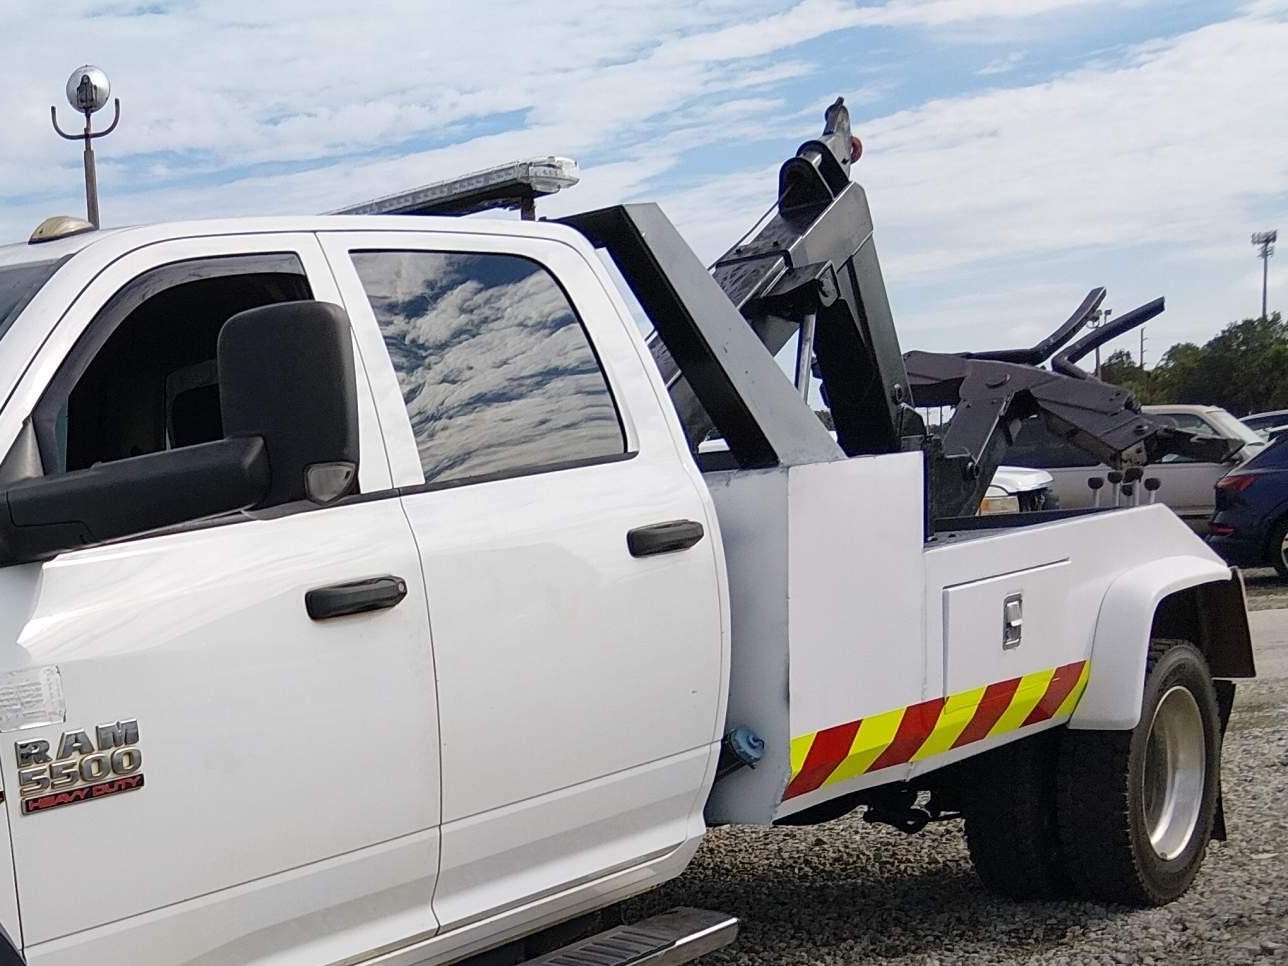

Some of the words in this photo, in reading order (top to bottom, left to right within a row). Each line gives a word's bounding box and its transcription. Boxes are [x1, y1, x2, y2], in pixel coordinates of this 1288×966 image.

[14, 718, 140, 768] RAM
[17, 746, 142, 797] 5500
[27, 788, 90, 812] HEAVY
[92, 776, 142, 797] DUTY
